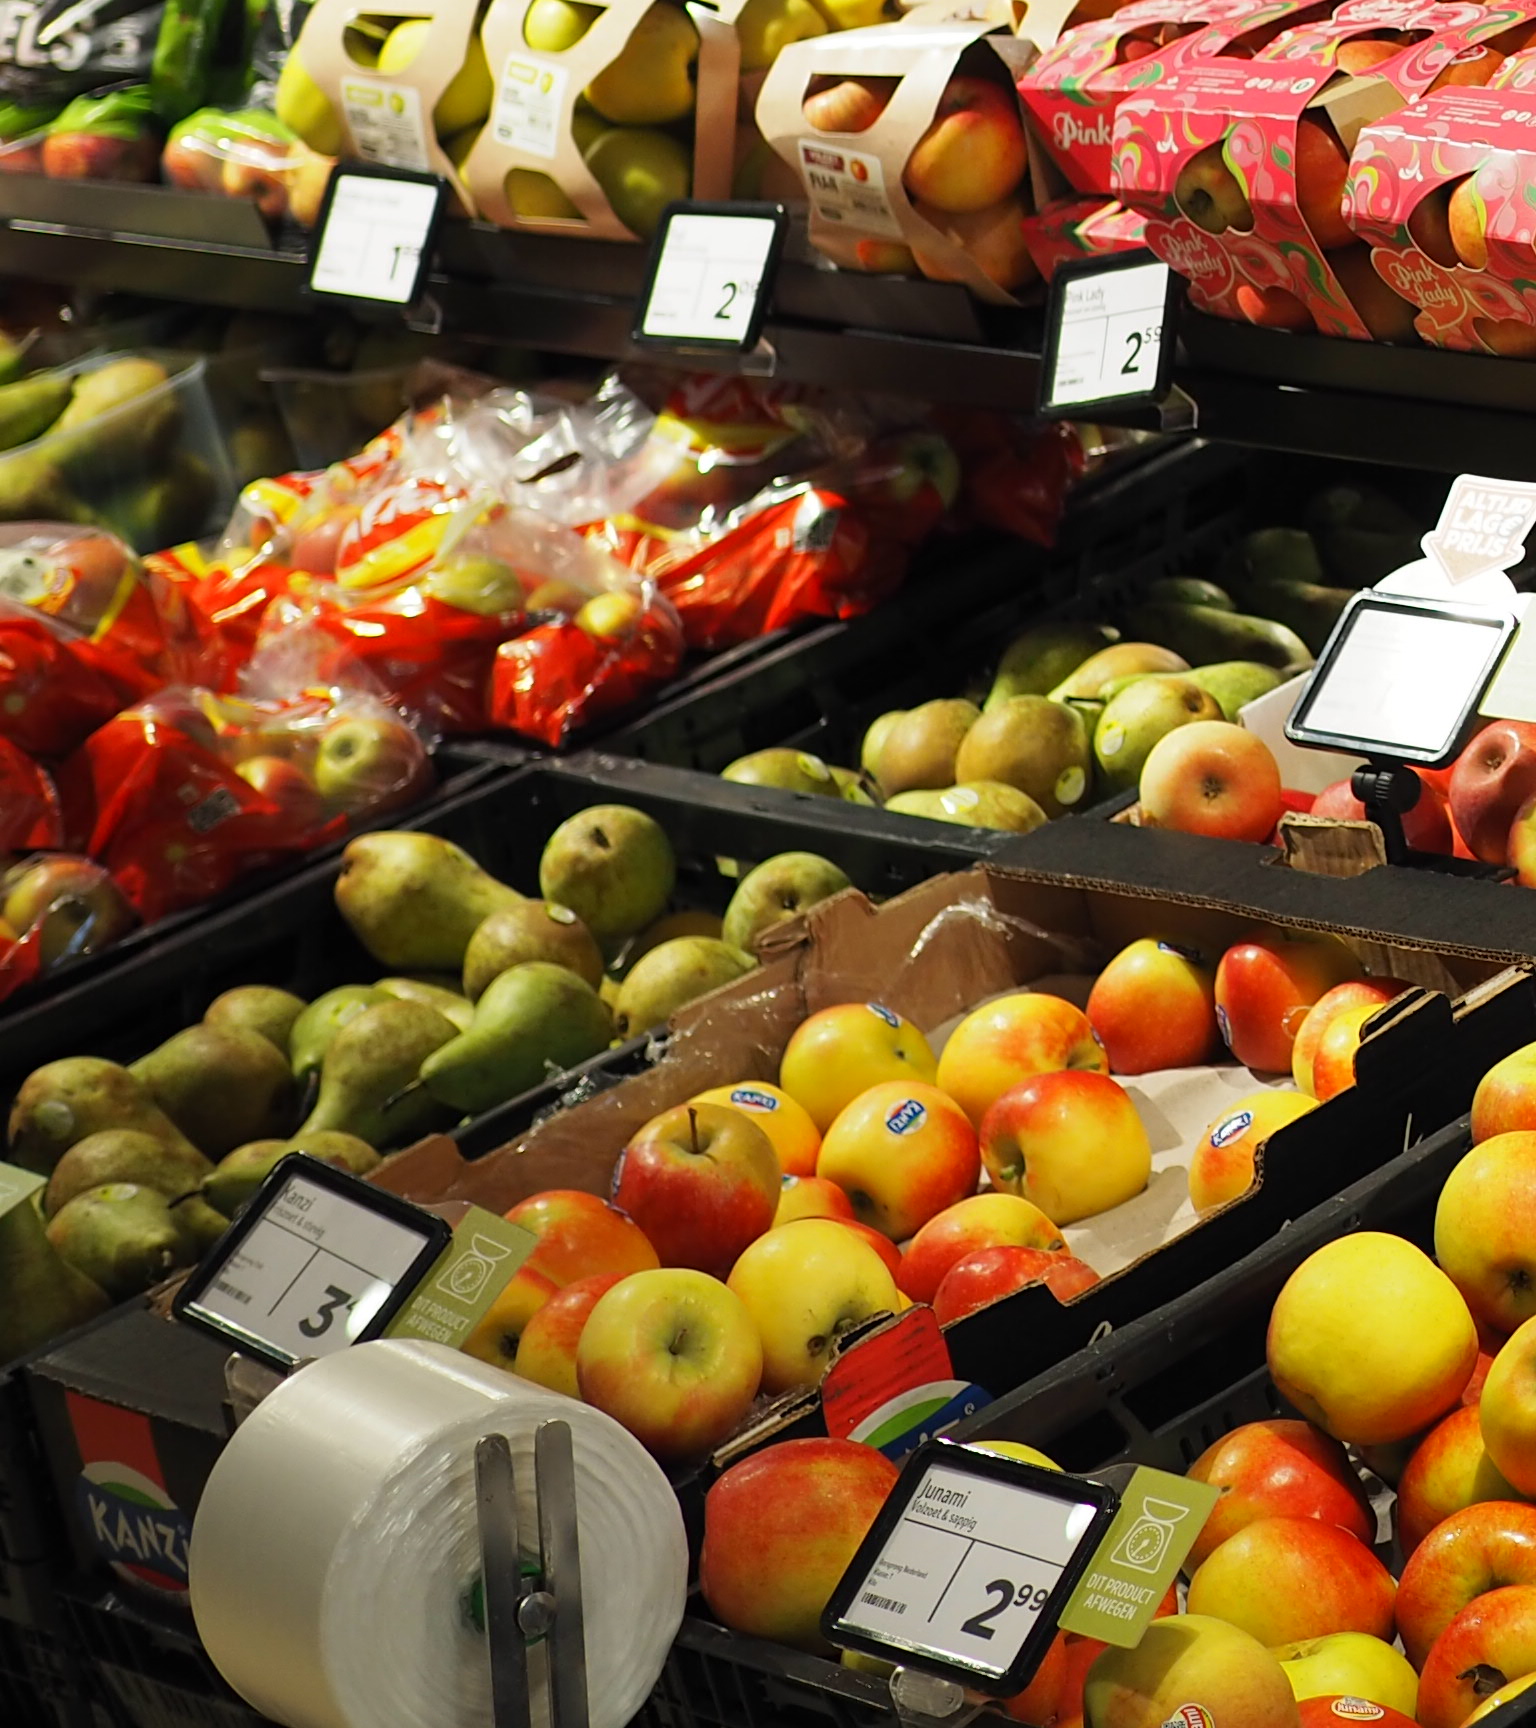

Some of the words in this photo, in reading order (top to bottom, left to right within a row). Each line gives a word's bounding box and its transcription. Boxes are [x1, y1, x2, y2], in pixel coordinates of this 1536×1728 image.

[1160, 230, 1208, 261] Pink
[1395, 263, 1435, 289] Pink
[1415, 281, 1457, 310] Lady
[280, 1182, 317, 1212] Kanzi
[410, 1296, 431, 1315] DIT
[428, 1304, 470, 1331] PRODUCT
[406, 1315, 452, 1344] AFWEGEN
[916, 1477, 971, 1509] Junami
[911, 1498, 942, 1520] Volzoet
[948, 1512, 978, 1533] sappig
[1085, 1572, 1107, 1593] DIT
[1104, 1578, 1155, 1605] PRODUCT
[1082, 1592, 1139, 1622] AFWEGEN
